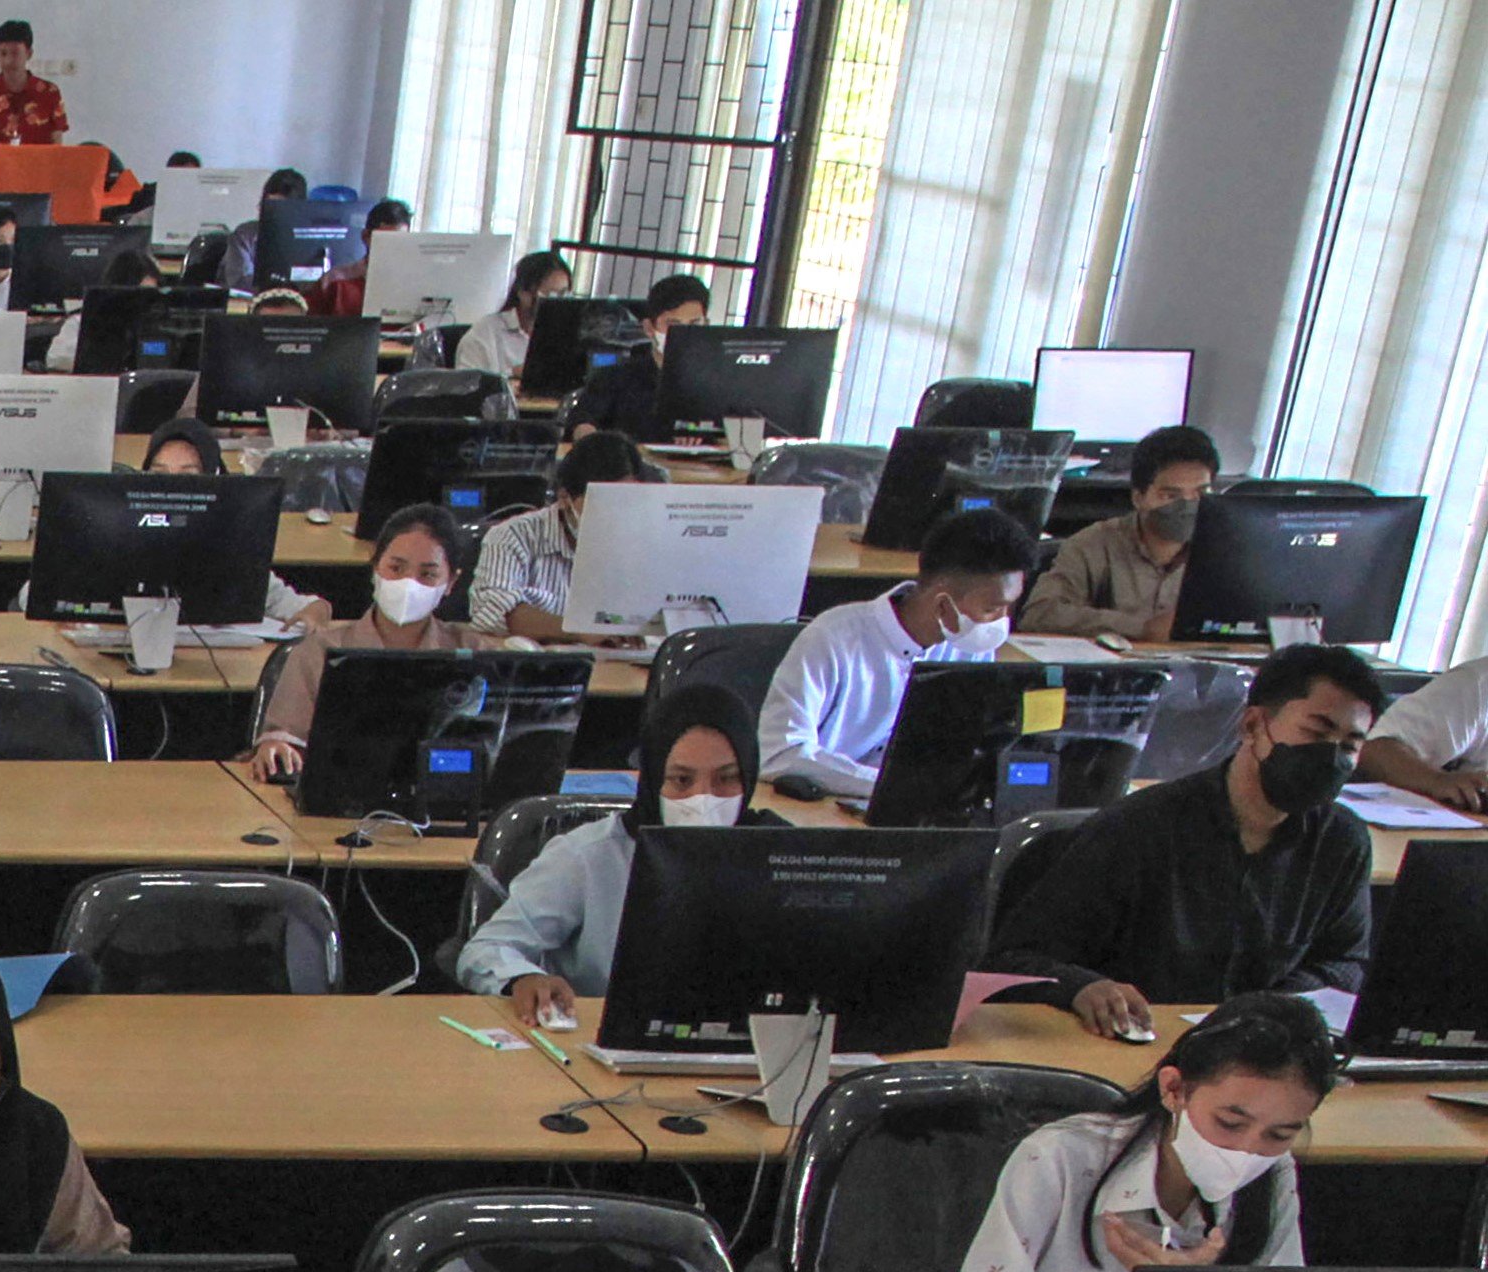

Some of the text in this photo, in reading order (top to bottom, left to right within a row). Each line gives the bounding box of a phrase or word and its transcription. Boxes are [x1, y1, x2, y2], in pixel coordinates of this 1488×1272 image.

[276, 344, 311, 353] ASUS
[736, 354, 771, 365] ASUS
[681, 525, 729, 537] ASUS
